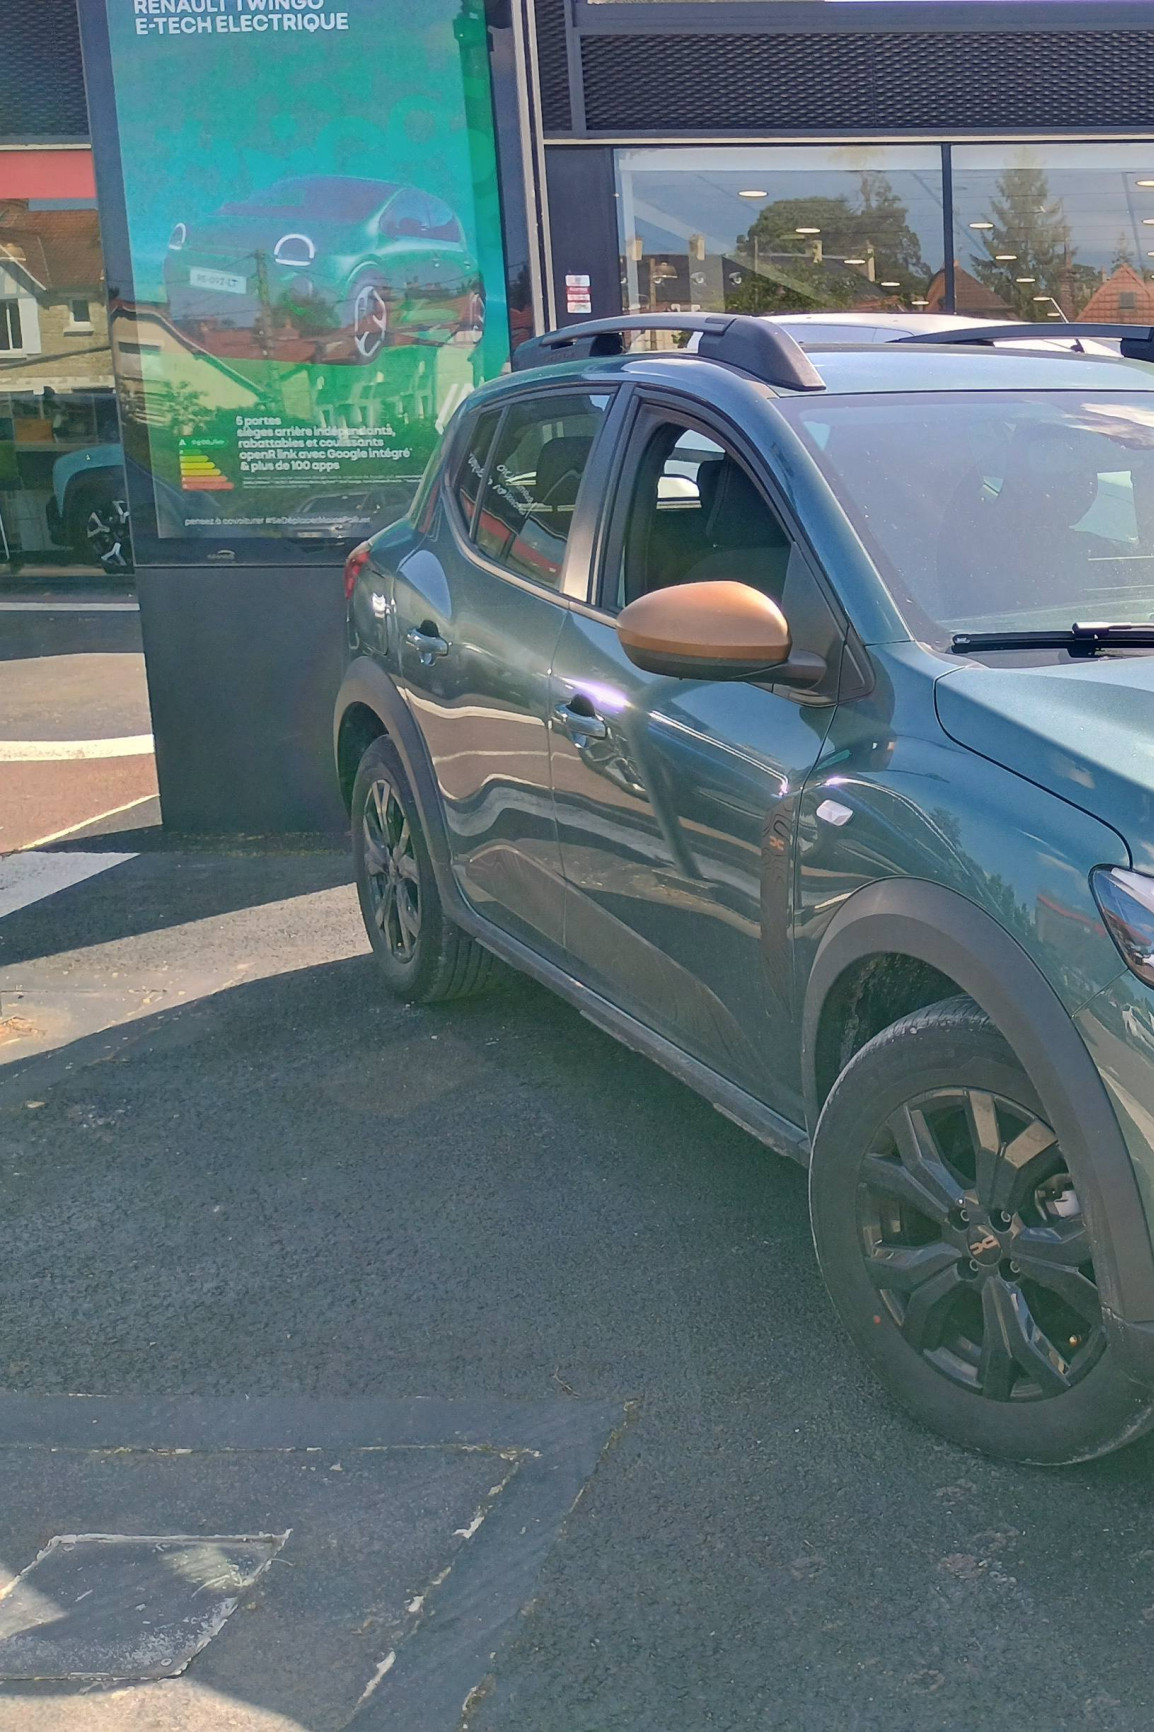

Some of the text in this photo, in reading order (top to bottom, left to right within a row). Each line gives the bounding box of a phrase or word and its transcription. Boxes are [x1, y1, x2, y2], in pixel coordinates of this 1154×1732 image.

[133, 0, 324, 14] RENAULT TWINGO
[135, 12, 349, 35] E-TECH ELECTRIQUE
[244, 416, 282, 428] portes
[237, 426, 274, 439] sièges
[275, 426, 312, 437] arrière
[238, 437, 384, 448] rabattables et coulissants
[277, 449, 297, 459] link
[298, 451, 326, 460] avec
[327, 449, 368, 462] Google
[240, 460, 340, 473] & plus de 100 apps
